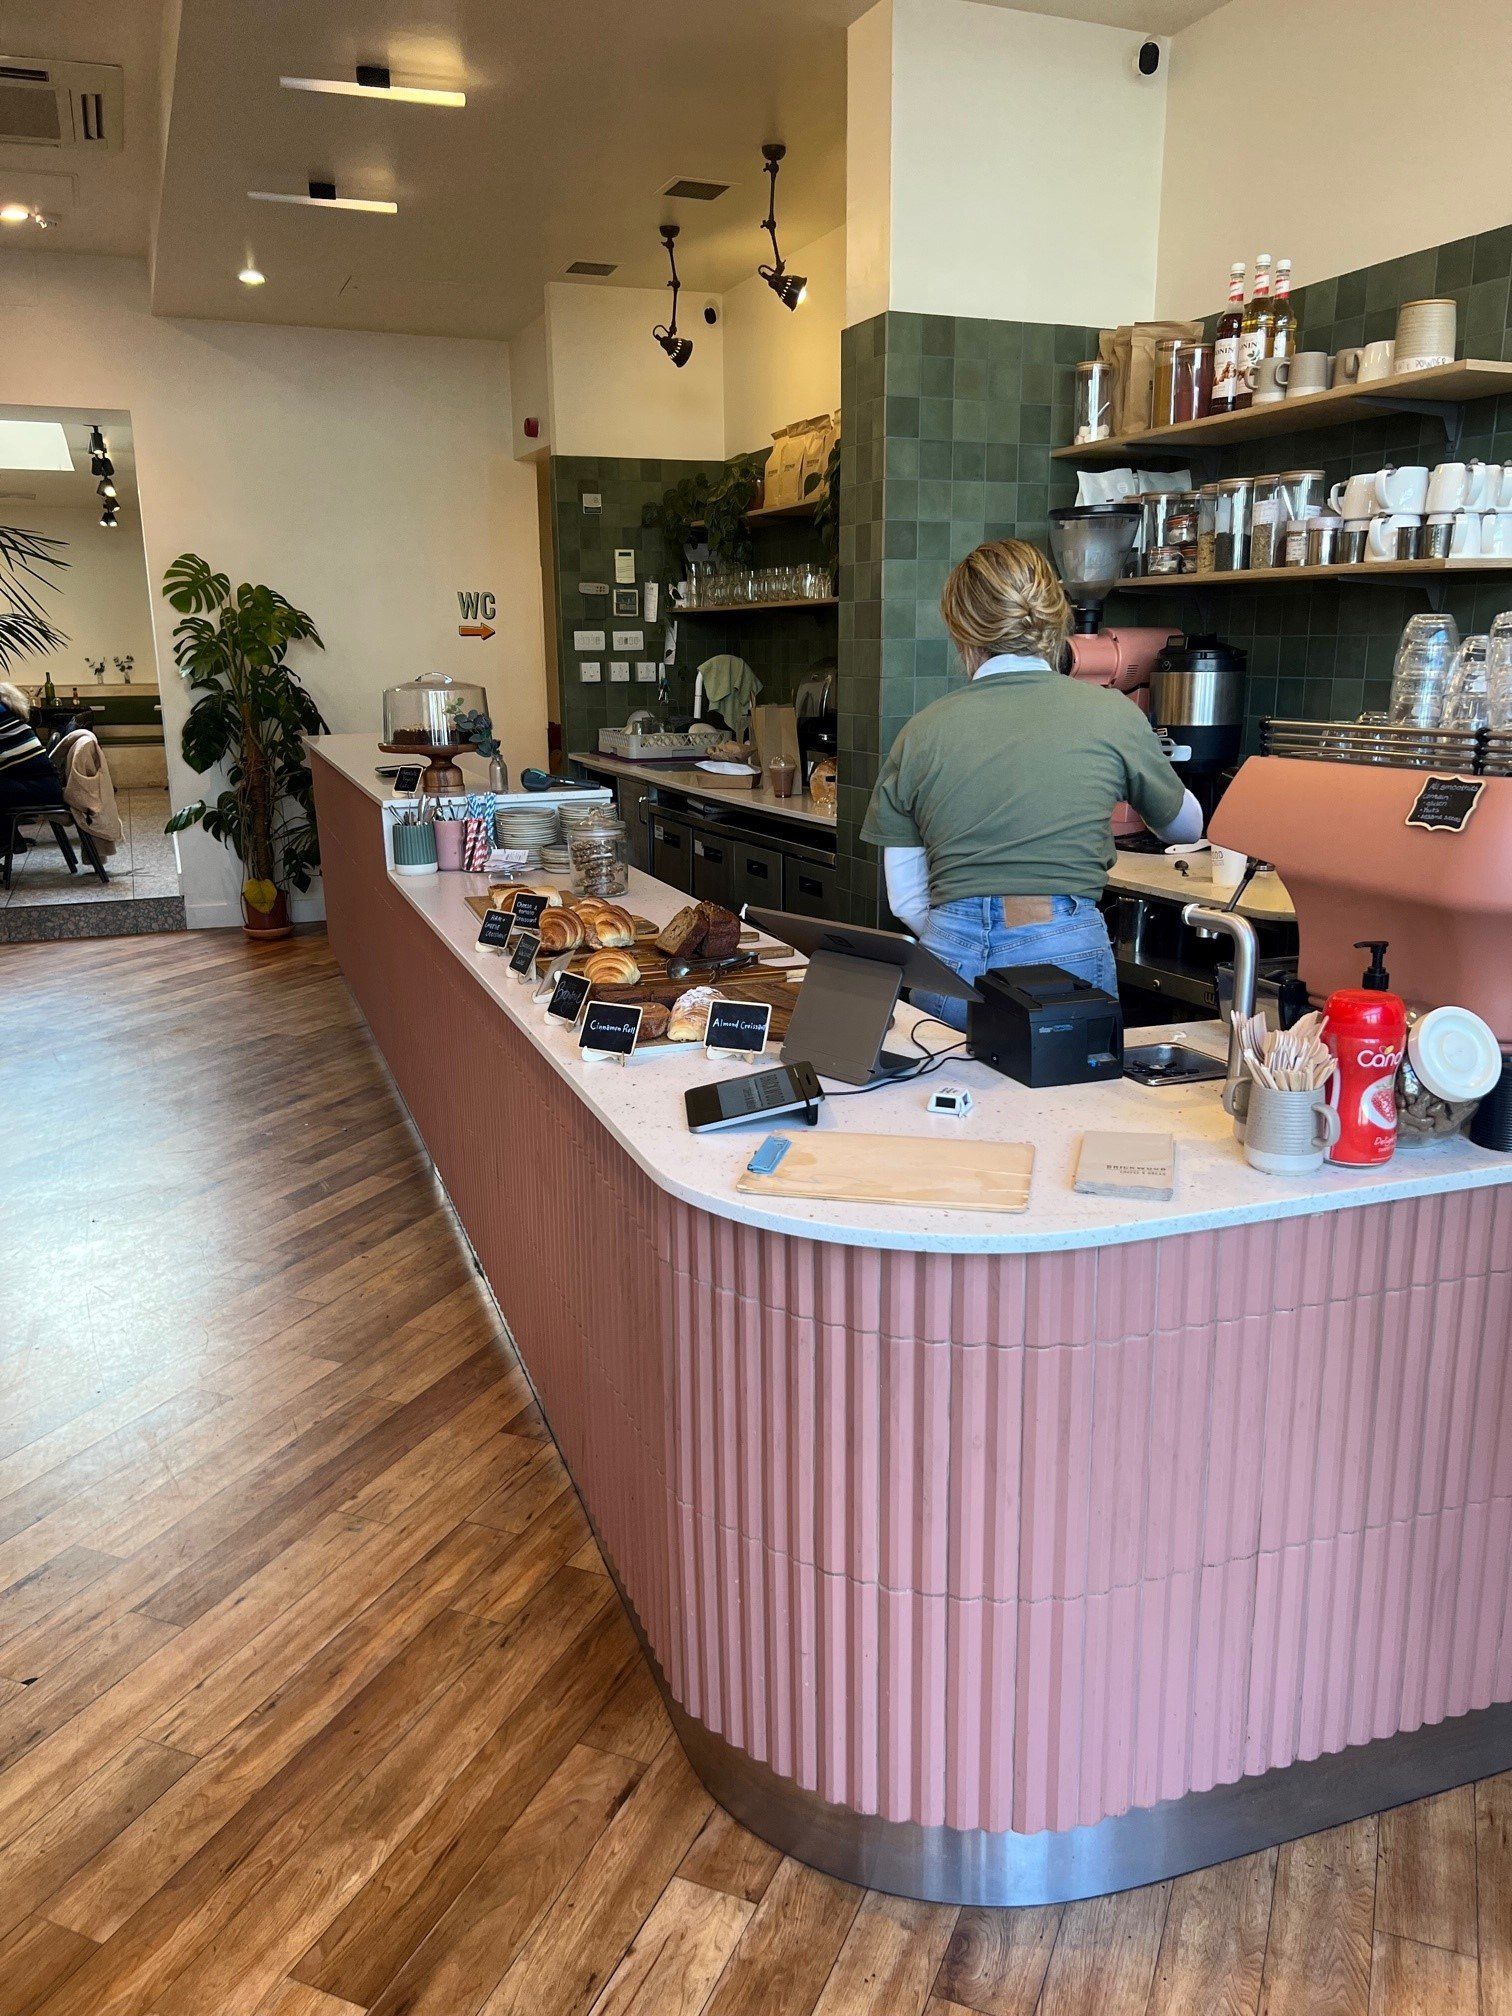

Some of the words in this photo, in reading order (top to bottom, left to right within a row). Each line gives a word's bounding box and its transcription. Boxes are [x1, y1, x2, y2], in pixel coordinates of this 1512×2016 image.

[1215, 347, 1234, 355] ONIN
[457, 591, 496, 620] WC
[590, 1020, 622, 1032] Cinnamon
[622, 1023, 636, 1034] Roll
[712, 1017, 740, 1029] Almond
